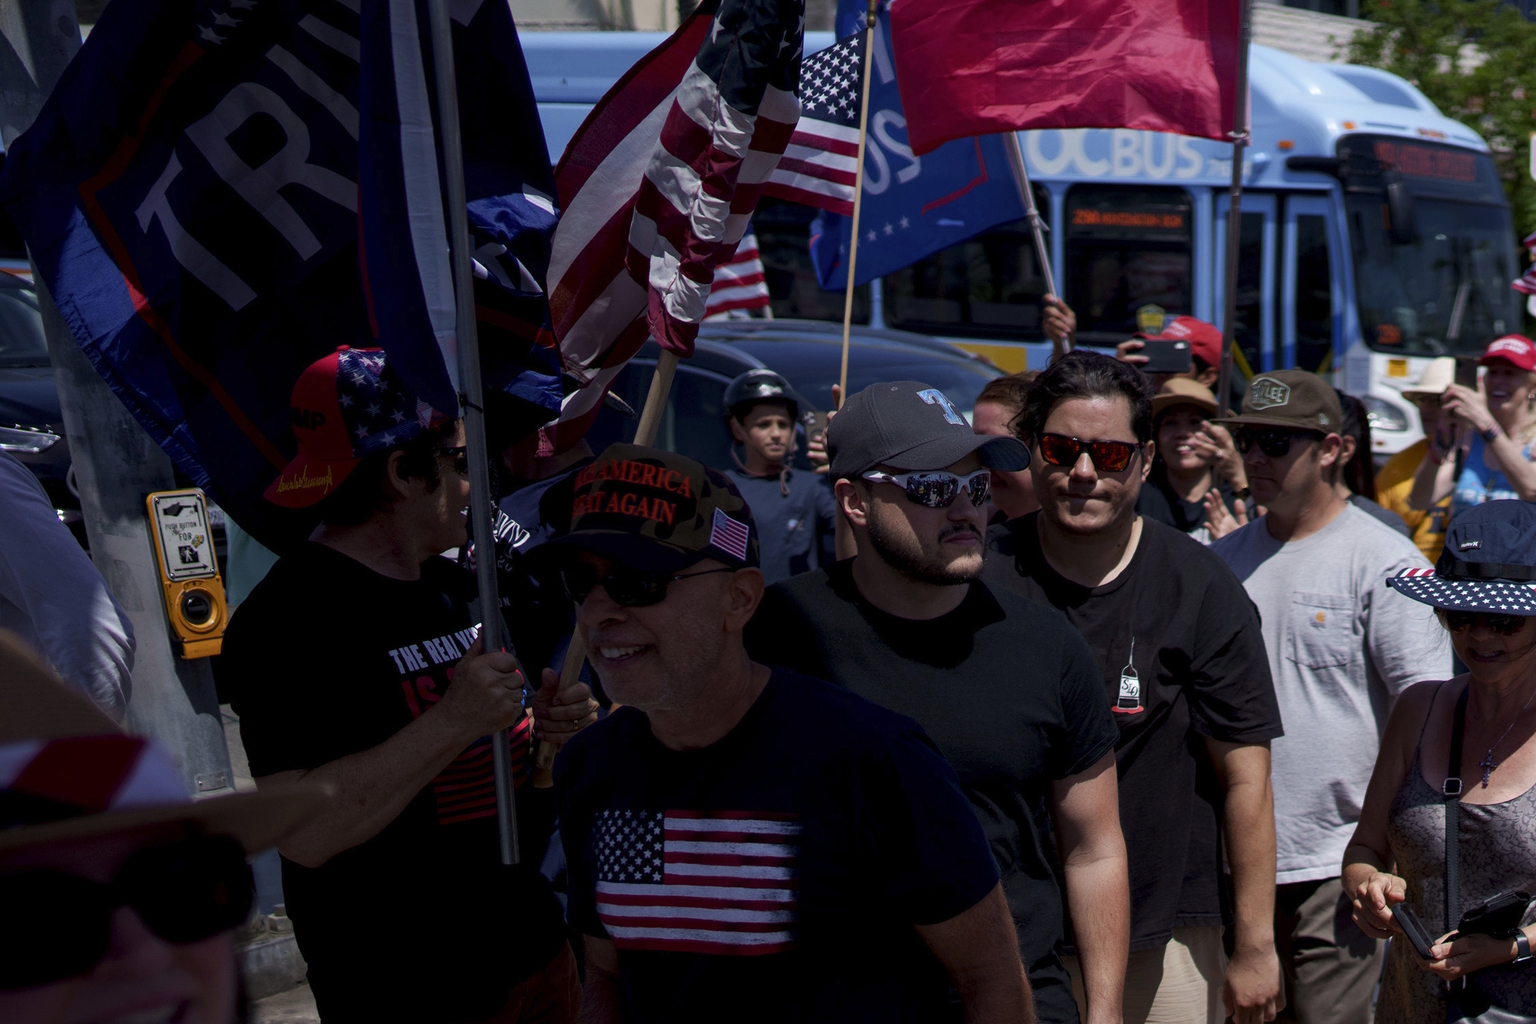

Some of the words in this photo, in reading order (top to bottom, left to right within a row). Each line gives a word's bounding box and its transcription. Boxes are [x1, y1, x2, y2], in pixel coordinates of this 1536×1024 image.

[597, 459, 693, 499] AMERICA
[180, 521, 197, 529] BUTTON
[603, 491, 678, 527] AGAIN
[179, 532, 192, 541] FOR
[388, 643, 429, 675] THE
[422, 634, 462, 665] REAL
